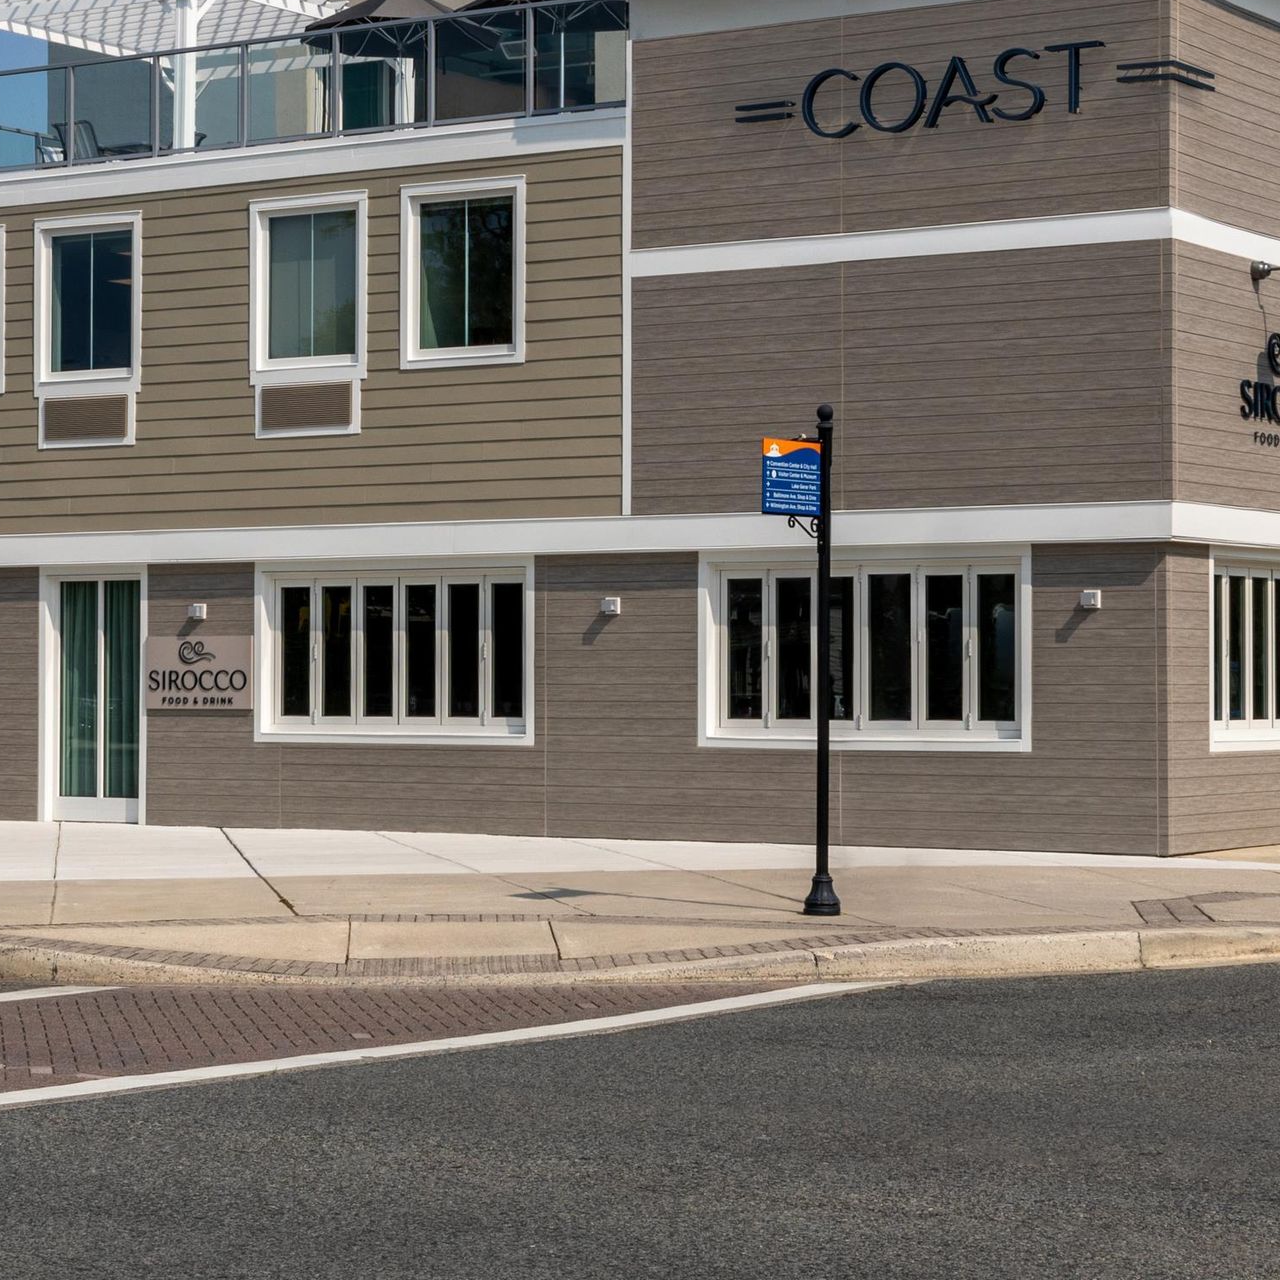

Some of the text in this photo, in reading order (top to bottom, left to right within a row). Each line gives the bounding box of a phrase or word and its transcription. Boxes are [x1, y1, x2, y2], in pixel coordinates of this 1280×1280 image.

[801, 40, 1107, 138] COAST
[1254, 431, 1280, 448] FOOD
[148, 669, 247, 691] SIROCCO
[161, 697, 234, 705] FOOD & DRINK
